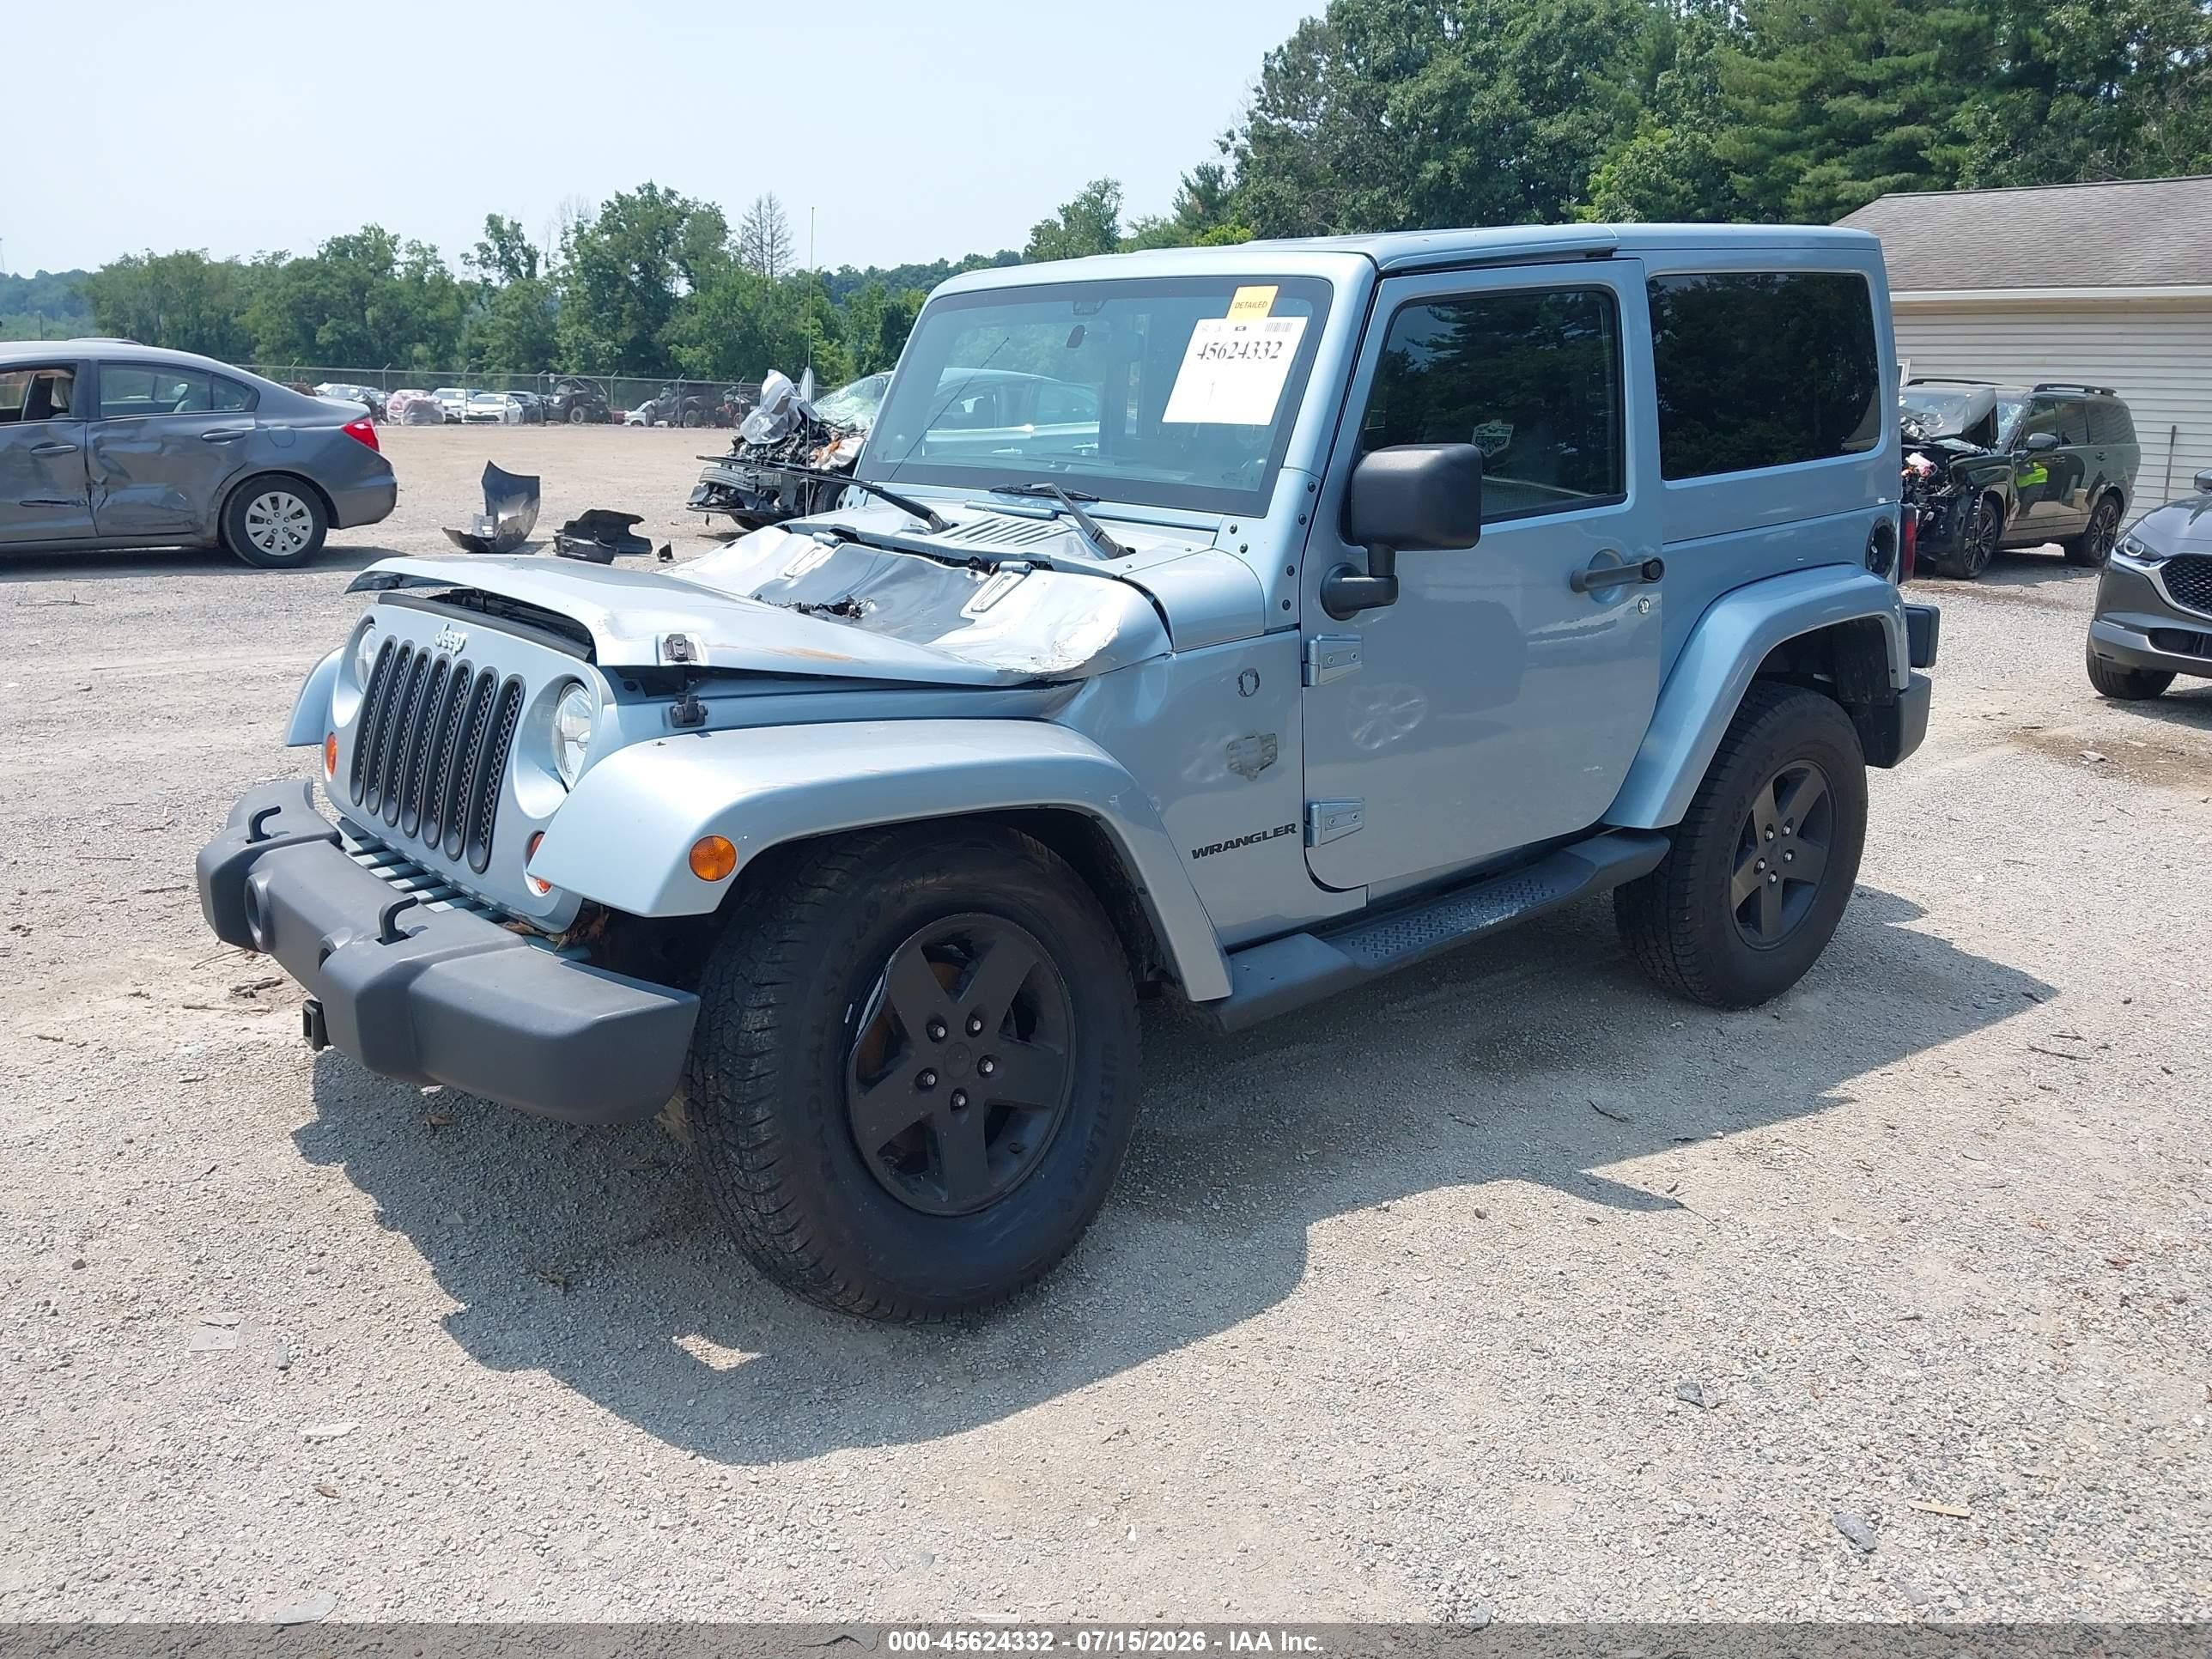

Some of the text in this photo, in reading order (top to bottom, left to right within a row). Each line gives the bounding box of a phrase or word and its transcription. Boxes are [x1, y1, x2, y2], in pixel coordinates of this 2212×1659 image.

[1234, 301, 1268, 309] DETAILED
[1196, 340, 1283, 362] 45624332
[434, 623, 467, 657] Jeep
[1191, 823, 1297, 860] WRANGLER
[1070, 1042, 1118, 1194] WESTLAKE
